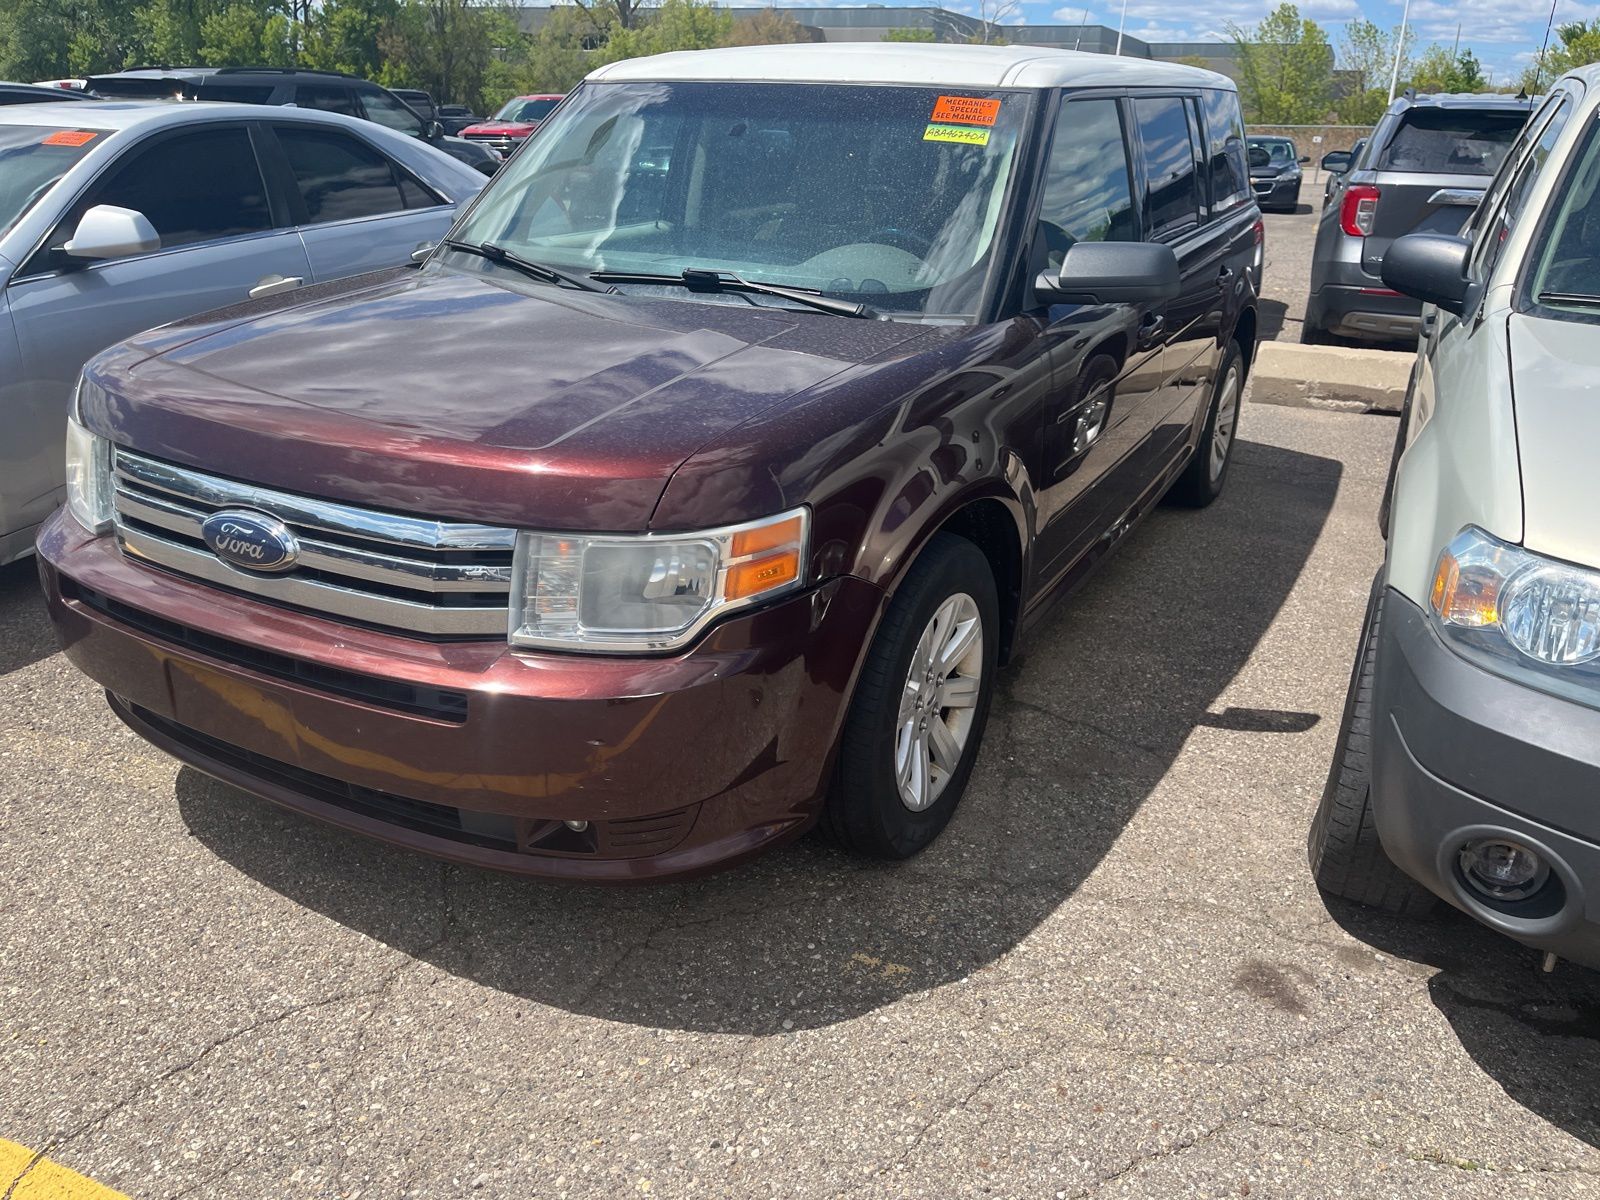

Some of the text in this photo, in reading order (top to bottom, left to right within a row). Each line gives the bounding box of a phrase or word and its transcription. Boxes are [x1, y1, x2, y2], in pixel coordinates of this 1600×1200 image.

[945, 98, 993, 108] MECHANICS
[950, 105, 983, 115] SPECIAL
[952, 113, 993, 123] MANAGER
[215, 522, 266, 559] Ford
